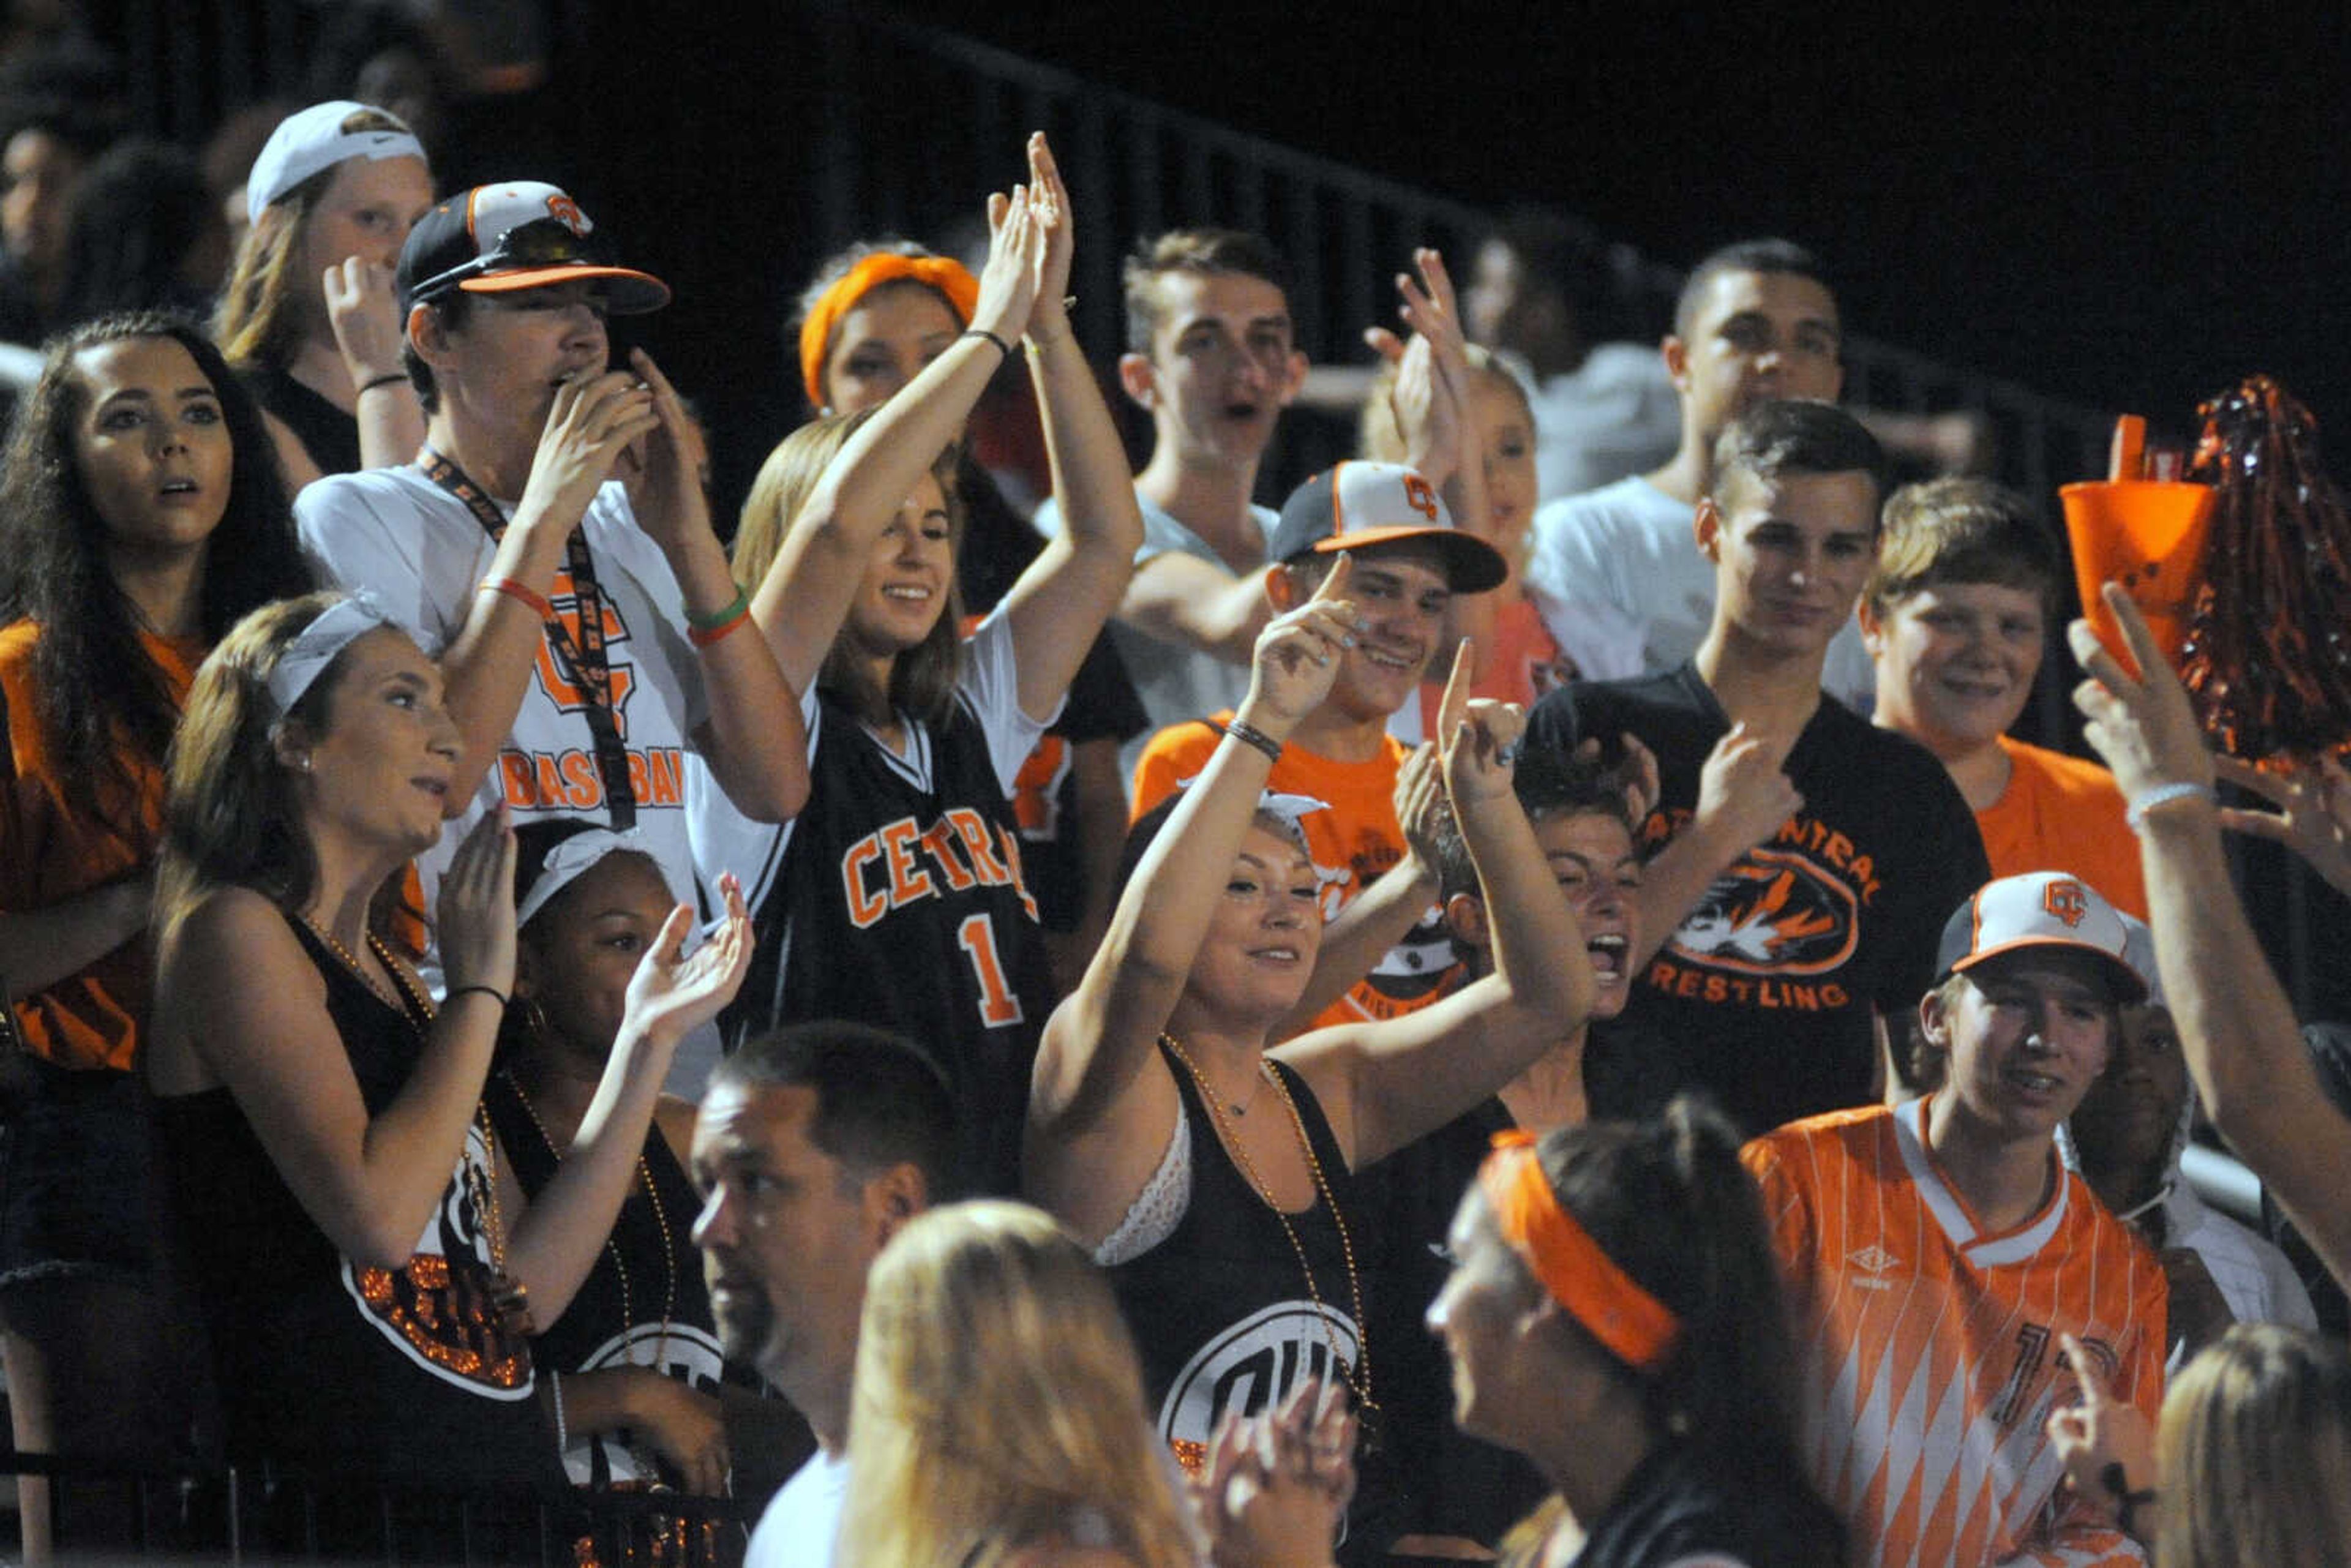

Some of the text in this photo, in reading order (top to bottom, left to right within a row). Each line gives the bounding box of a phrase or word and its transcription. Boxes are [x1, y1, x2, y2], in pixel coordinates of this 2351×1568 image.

[1779, 817, 1881, 906] NTRAL
[958, 913, 1024, 1028] 1
[1650, 961, 1851, 1011] RESTLING
